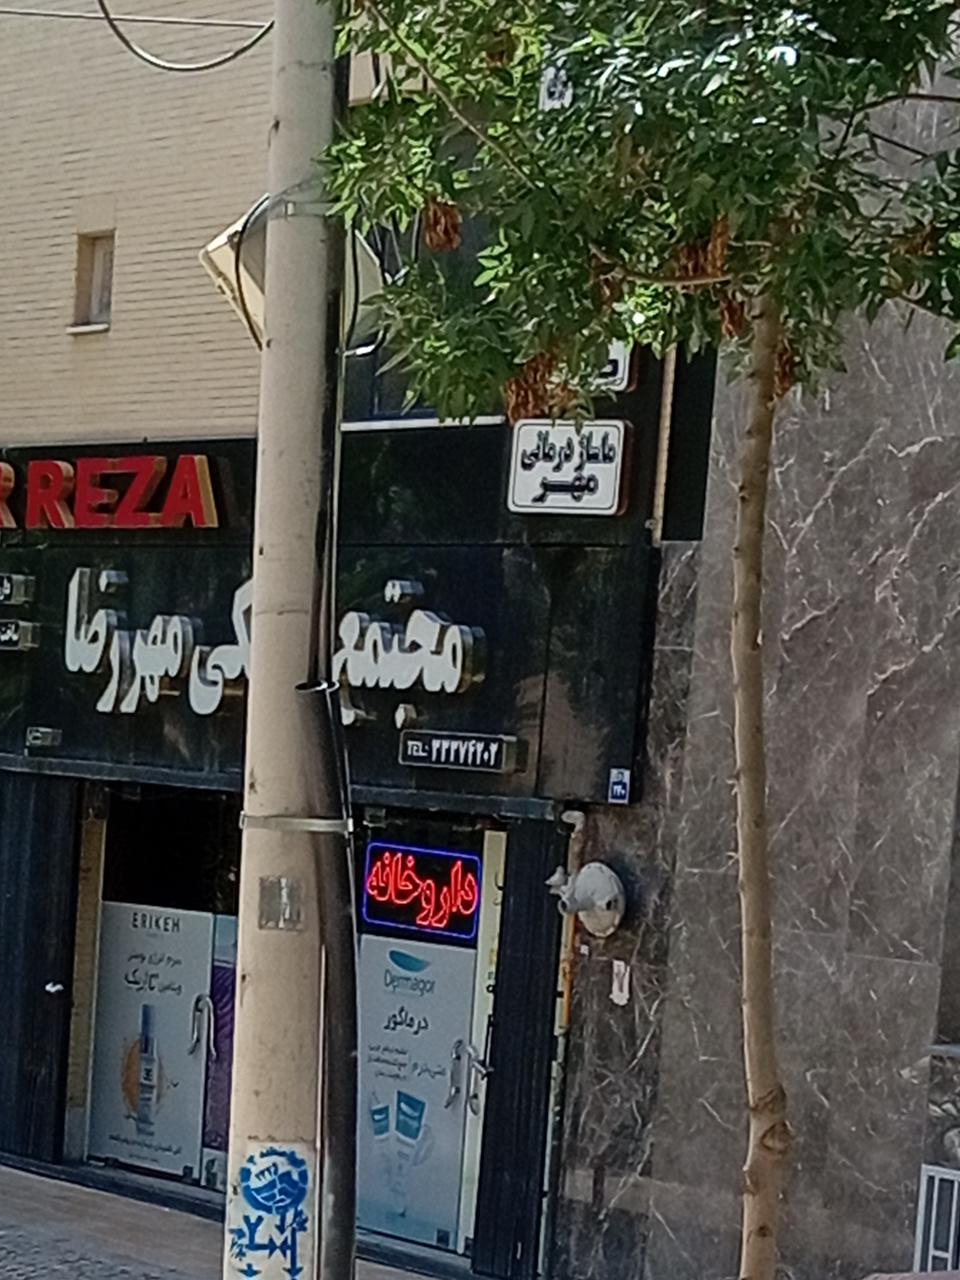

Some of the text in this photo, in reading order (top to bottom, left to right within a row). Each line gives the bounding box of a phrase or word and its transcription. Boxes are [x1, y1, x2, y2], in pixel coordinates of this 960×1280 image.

[521, 430, 574, 473] درمانی
[25, 454, 220, 530] REZA
[531, 472, 599, 502] مهر
[367, 851, 478, 928] داروخانه
[131, 911, 180, 933] ERIKEH
[383, 1005, 429, 1035] درماگور
